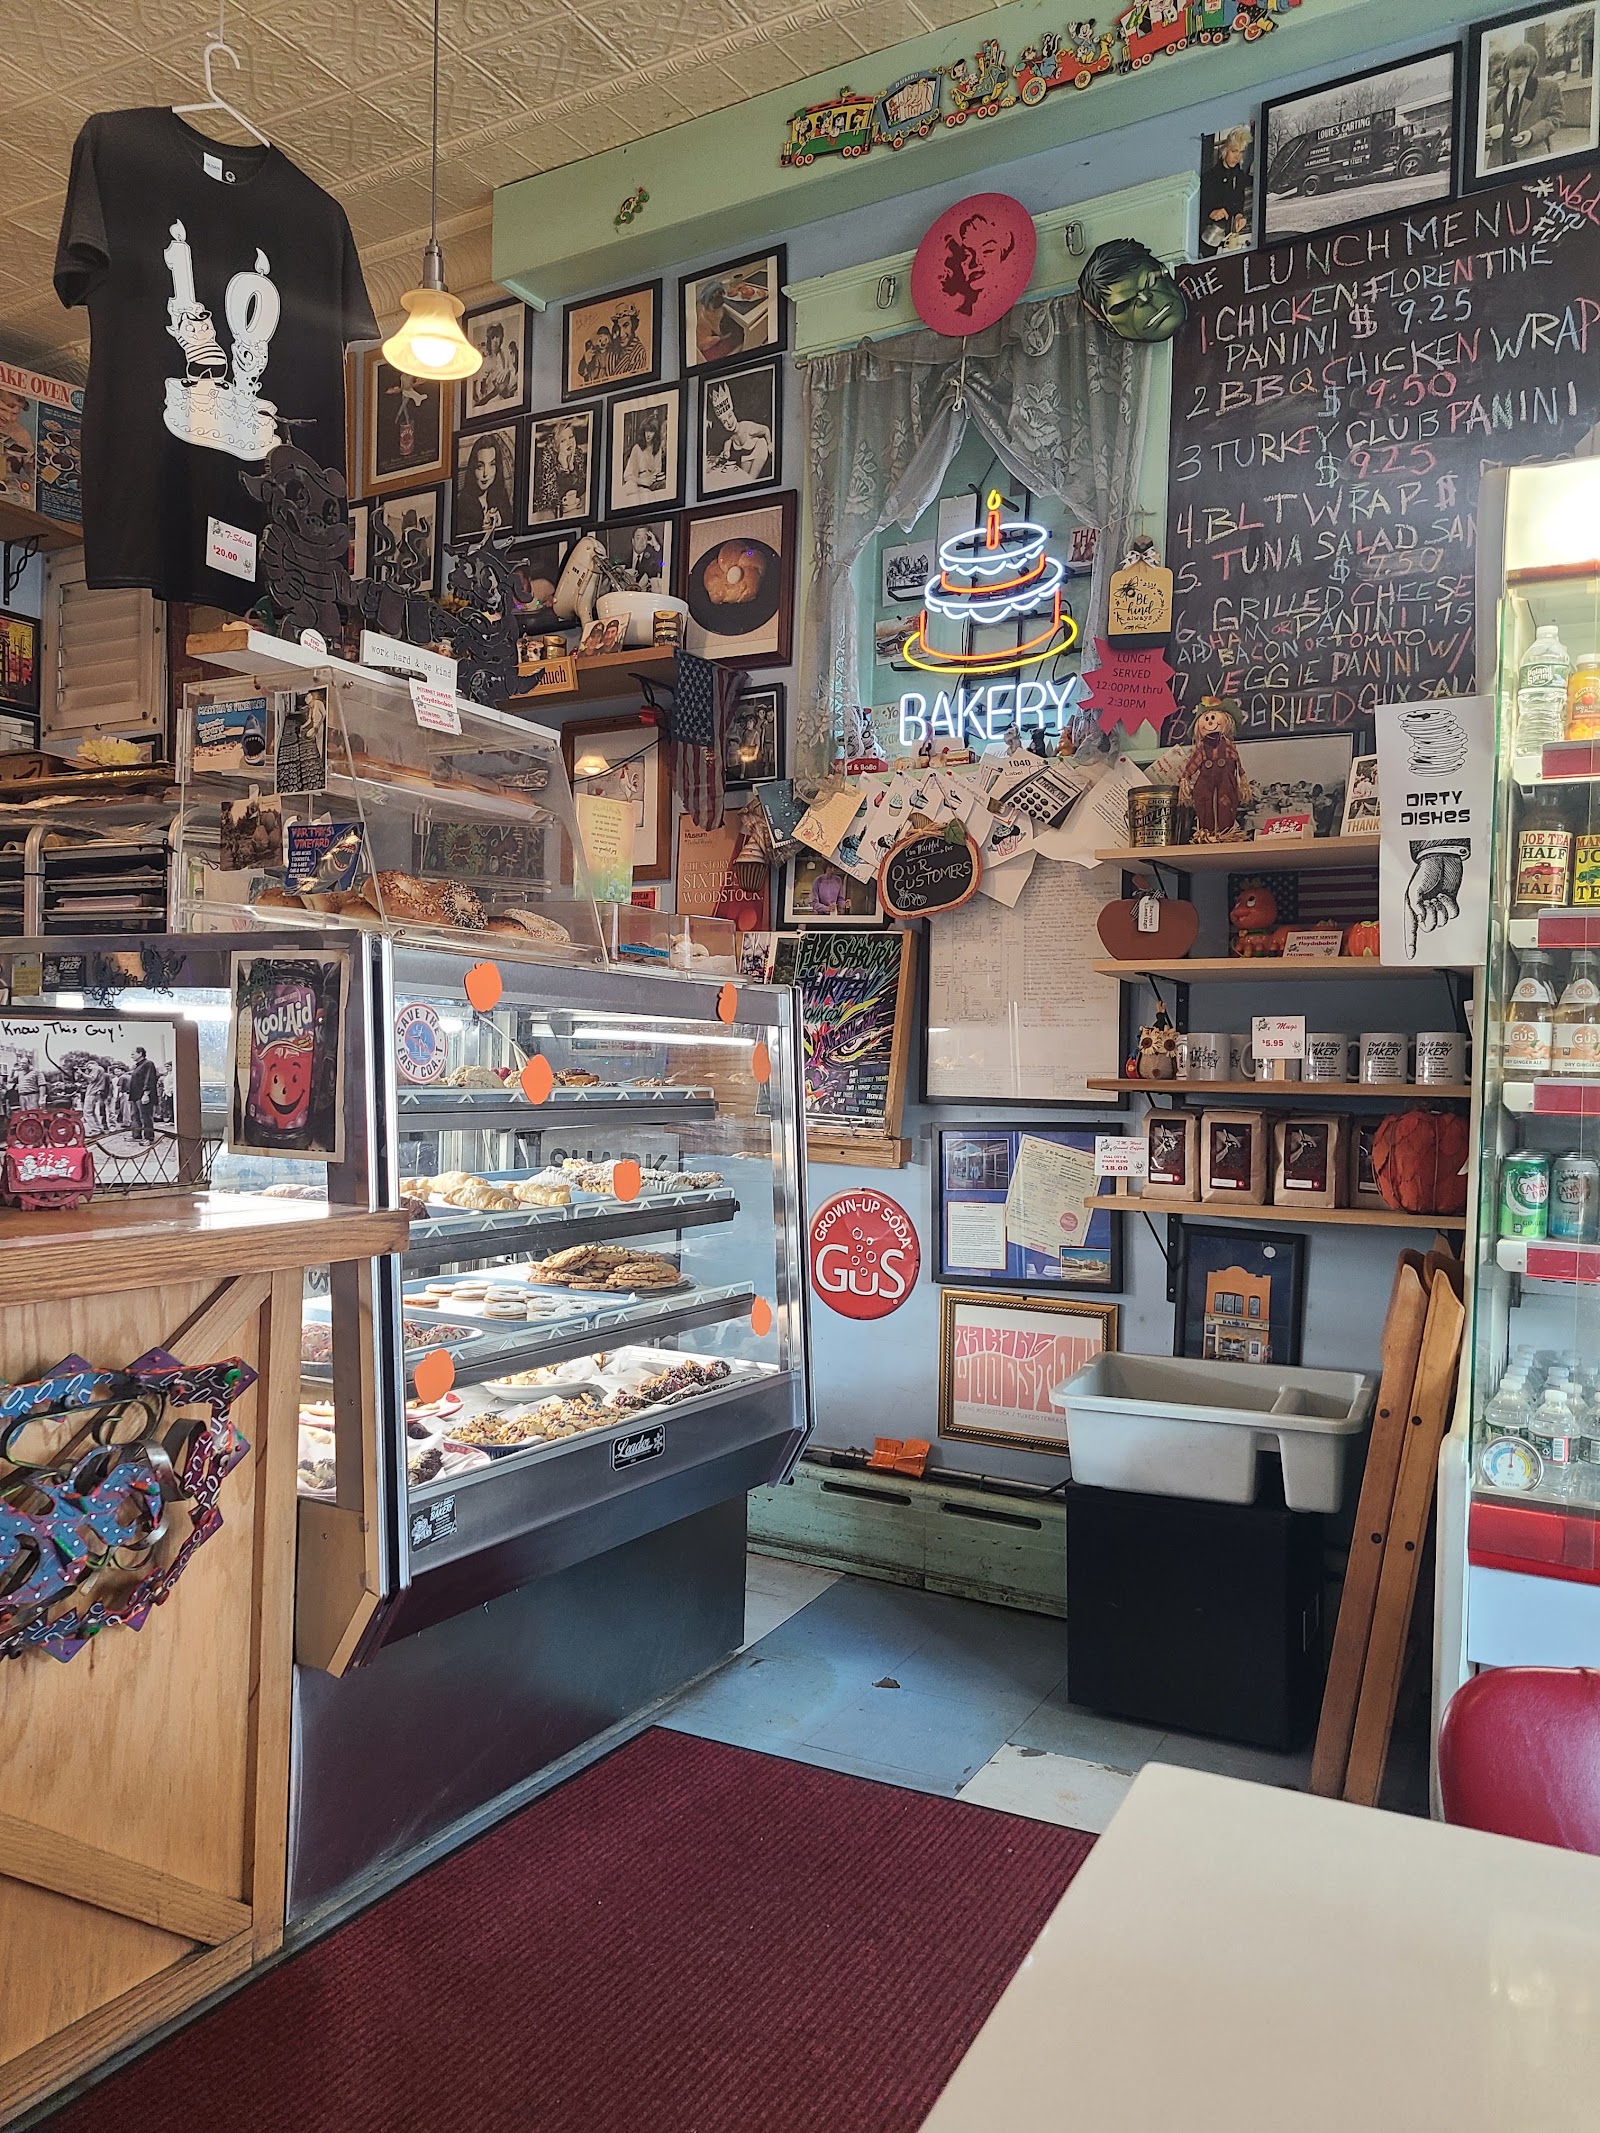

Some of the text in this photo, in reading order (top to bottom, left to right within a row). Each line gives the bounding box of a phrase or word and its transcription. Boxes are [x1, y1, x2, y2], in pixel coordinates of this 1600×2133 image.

[1341, 116, 1371, 133] CARTING
[1180, 197, 1533, 301] THE LUNCH MENU
[1215, 279, 1360, 343] CHICKEN
[1225, 318, 1338, 374] PANINI
[1398, 288, 1473, 335] 9.25
[1215, 366, 1319, 417] BBQ
[1320, 326, 1482, 388] CHICKEN
[1489, 296, 1600, 364] WRAP
[30, 376, 72, 403] OVEN
[1366, 370, 1458, 411] 9.50
[1210, 420, 1342, 473] TURKEY
[1344, 410, 1441, 450] CLUB
[1445, 381, 1578, 437] PANINI
[1347, 442, 1438, 480] 9.25
[1210, 533, 1303, 582] TUNA
[1313, 523, 1419, 562] SALAD
[1211, 584, 1346, 633] GRILLED
[1350, 574, 1474, 608] CHEESE
[1208, 621, 1271, 650] HAM
[1292, 604, 1409, 641] PANINI
[1116, 653, 1152, 664] LUNCH
[1217, 637, 1300, 668] BACON
[1328, 626, 1428, 651] TOMATO
[370, 645, 453, 679] work hard & be kind
[1112, 668, 1151, 679] SERVED
[1206, 658, 1321, 698] VEGGIE
[1330, 645, 1423, 685] PANINI
[1527, 665, 1552, 678] Poland
[1096, 680, 1163, 695] 12:00PM thru
[1527, 673, 1553, 686] Spring
[898, 675, 1078, 747] BAKERY
[1107, 697, 1147, 709] 2:30PM
[1250, 691, 1357, 734] GRILLED
[1008, 759, 1032, 768] 1040
[1406, 790, 1464, 808] DIRTY
[1347, 819, 1380, 833] THANK
[1522, 833, 1570, 847] JOE TEA
[700, 859, 730, 870] STORY
[1522, 847, 1567, 859] HALF
[891, 858, 933, 881] OUR
[893, 861, 972, 892] CUSTOMERS
[1517, 882, 1564, 896] HALF
[1, 1020, 125, 1044] Know This Guy!
[396, 1008, 441, 1037] SAVE THE
[1275, 1022, 1298, 1032] Mugs
[1262, 1039, 1284, 1047] $5.95
[1367, 1047, 1402, 1056] BAKERY
[1418, 1047, 1453, 1056] BAKERY
[397, 1045, 444, 1078] EAST COAT
[813, 1197, 881, 1243] GROWN-UP
[879, 1206, 912, 1250] SODA
